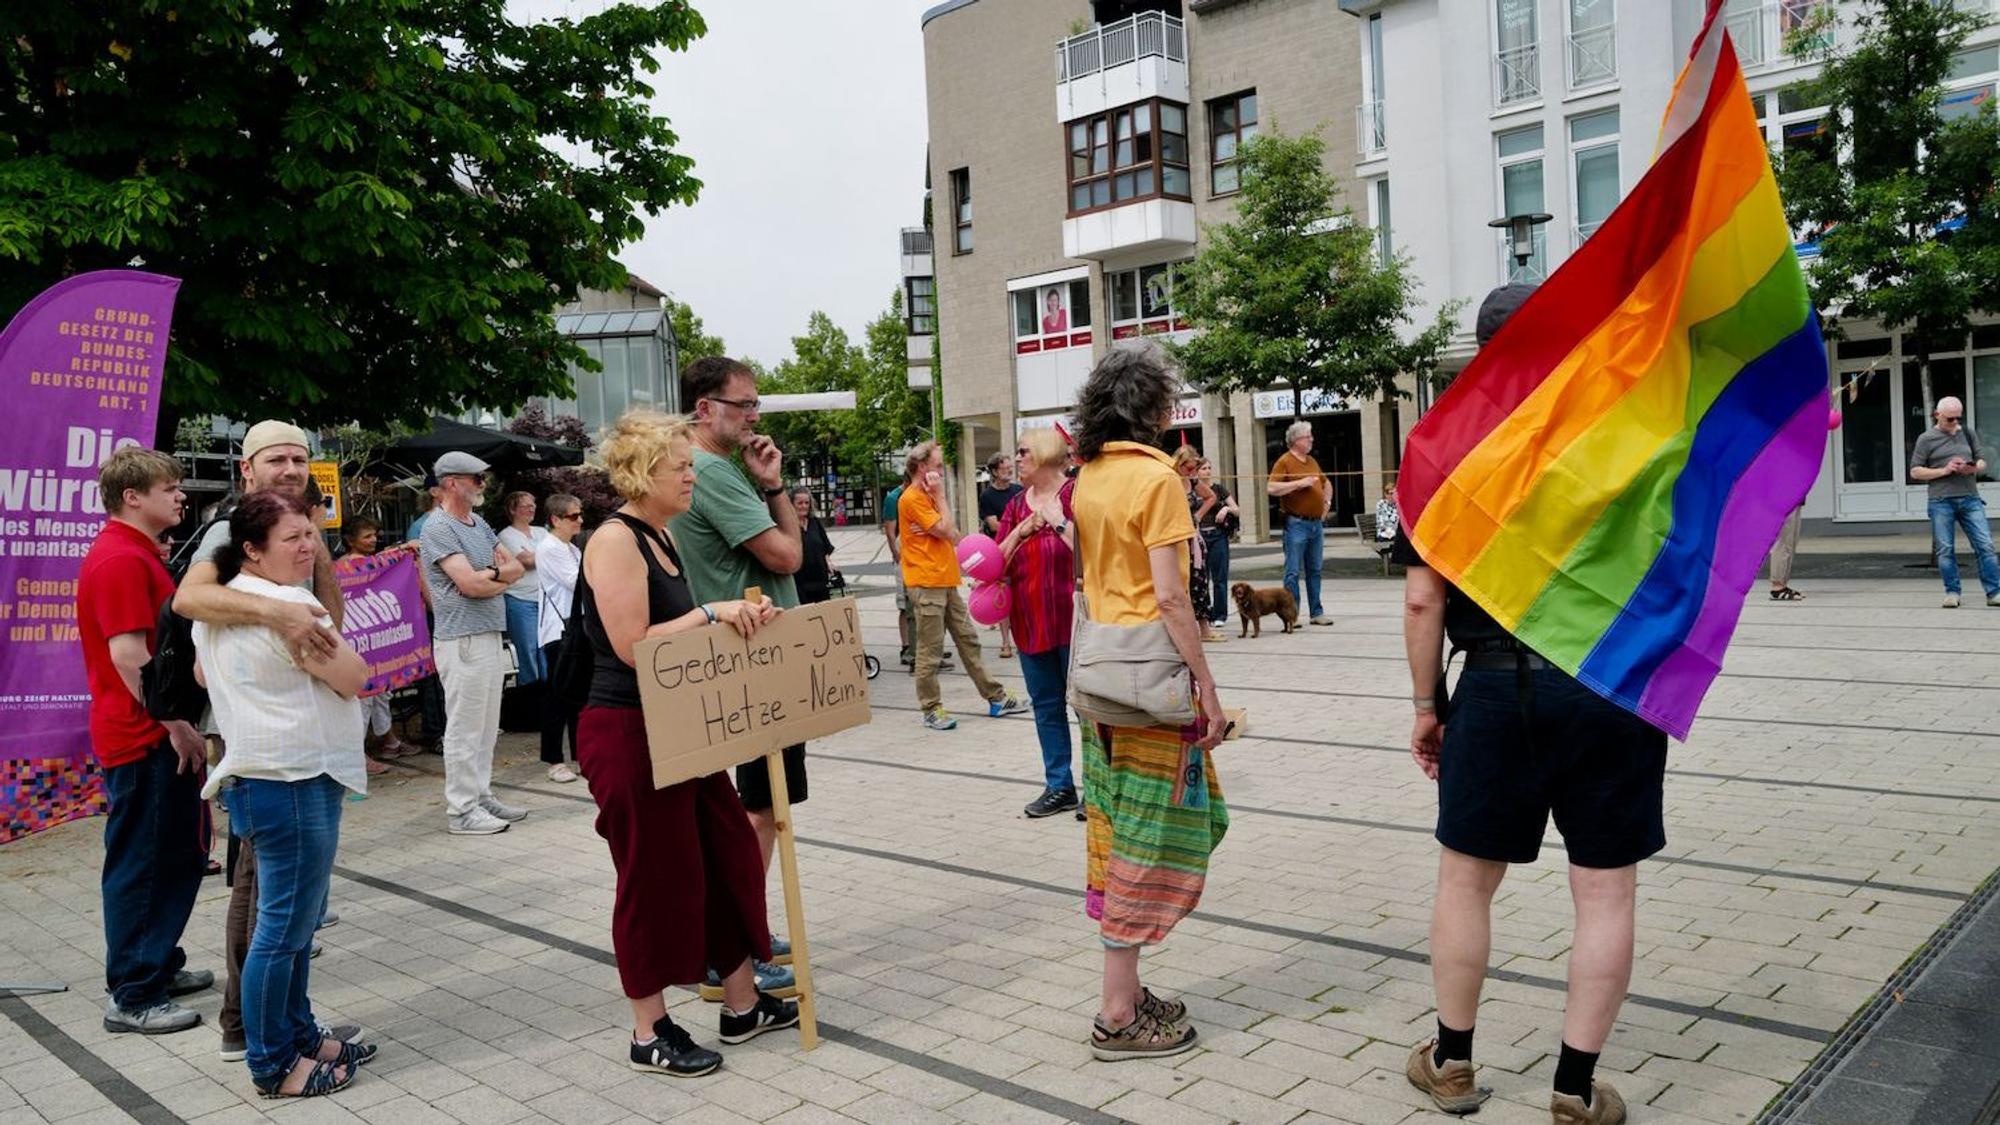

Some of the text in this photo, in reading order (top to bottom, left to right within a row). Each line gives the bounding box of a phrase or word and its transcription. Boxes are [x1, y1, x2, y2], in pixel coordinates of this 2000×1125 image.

[95, 308, 156, 326] GRUND-
[59, 322, 154, 344] GESETZ DER
[81, 341, 152, 360] BUNDES-
[71, 357, 150, 378] REPUBLIK
[30, 371, 149, 395] DEUTSCHLAND
[99, 395, 147, 412] ART. 1
[1277, 395, 1297, 411] Eis
[10, 541, 95, 558] unantas
[16, 577, 79, 596] Gemei
[341, 588, 402, 634] ürde
[10, 624, 46, 641] und
[653, 635, 783, 689] Gedenken
[701, 684, 786, 746] Hetze
